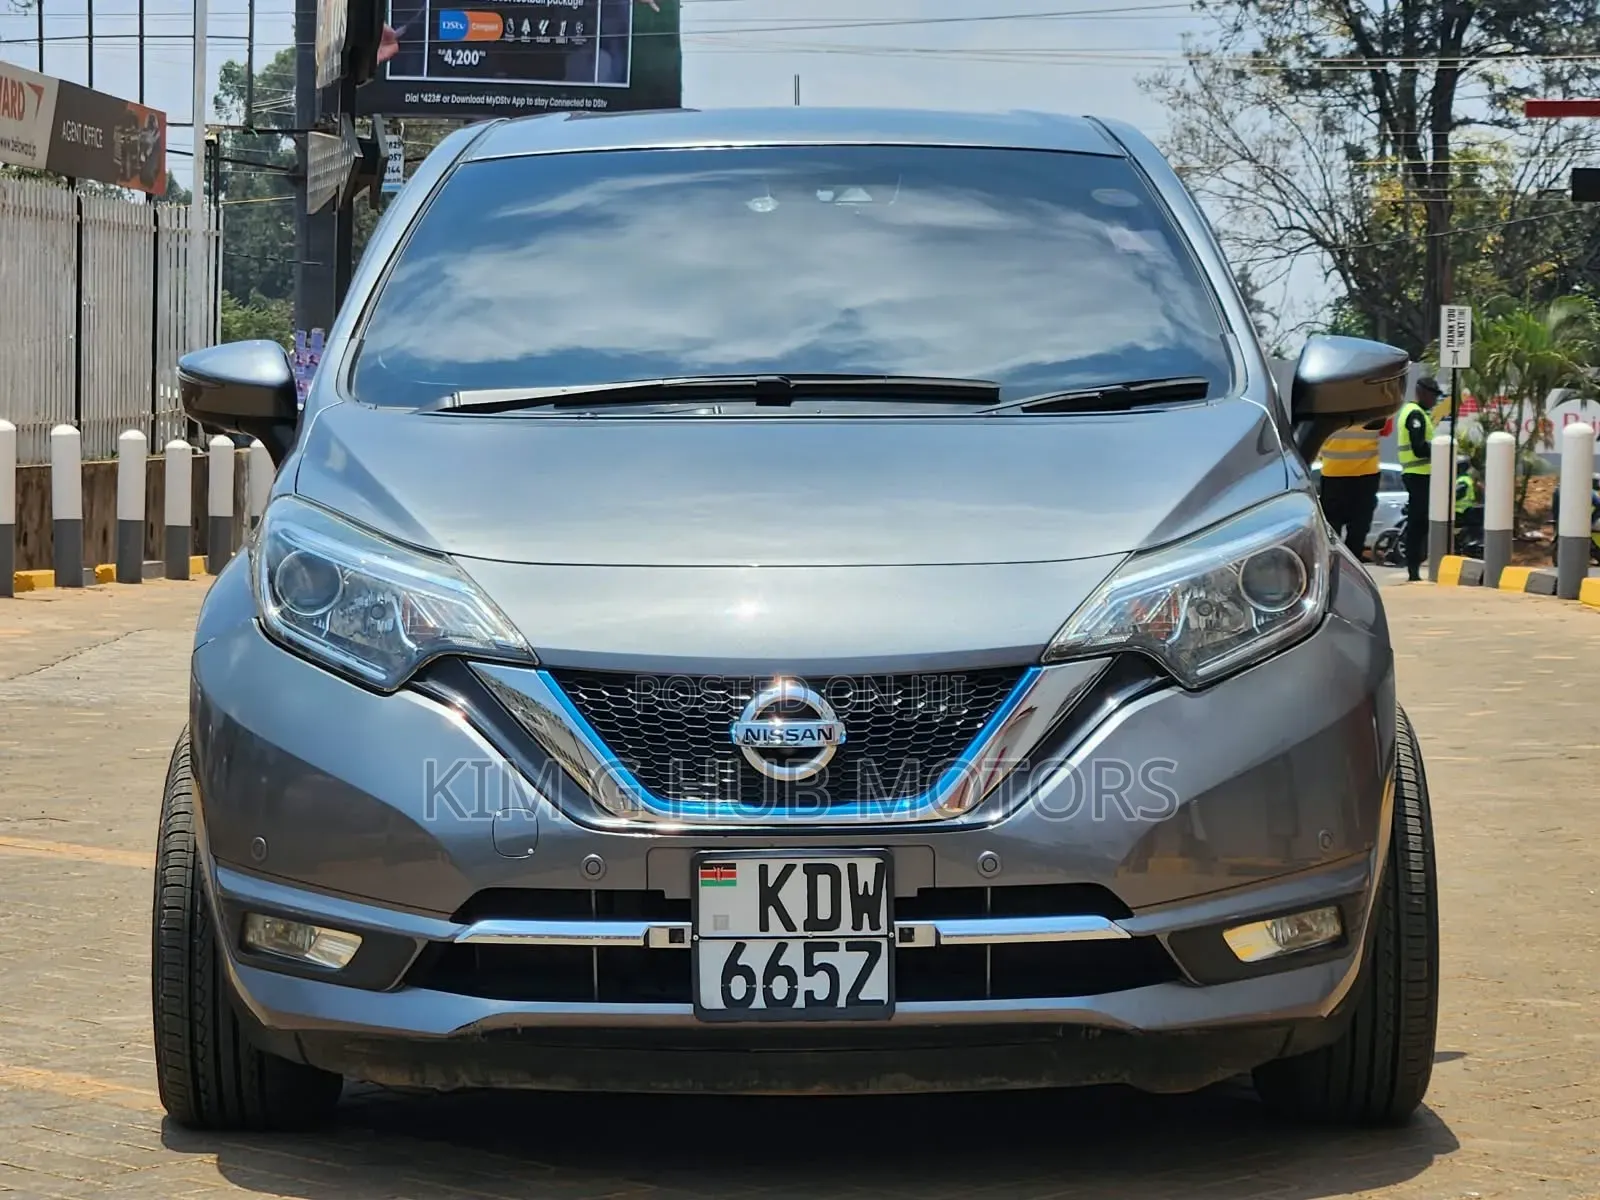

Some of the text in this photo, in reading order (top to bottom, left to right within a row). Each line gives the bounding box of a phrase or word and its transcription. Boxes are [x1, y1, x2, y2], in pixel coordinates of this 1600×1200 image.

[442, 21, 466, 30] DStv
[0, 75, 25, 121] ARD
[405, 93, 419, 103] Dial
[442, 95, 450, 103] or
[451, 94, 484, 104] Download
[486, 95, 511, 107] MyDStv
[512, 96, 526, 107] App
[527, 97, 533, 105] to
[534, 97, 549, 109] stay
[549, 97, 584, 107] Connected
[585, 98, 592, 107] to
[593, 99, 607, 108] DStv
[61, 120, 103, 149] AGENT OFFICE
[1446, 308, 1456, 348] THANK YOU
[1457, 322, 1465, 338] NEXT
[744, 727, 834, 742] NISSAN
[758, 863, 885, 932] KDW
[721, 941, 886, 1009] 665Z
